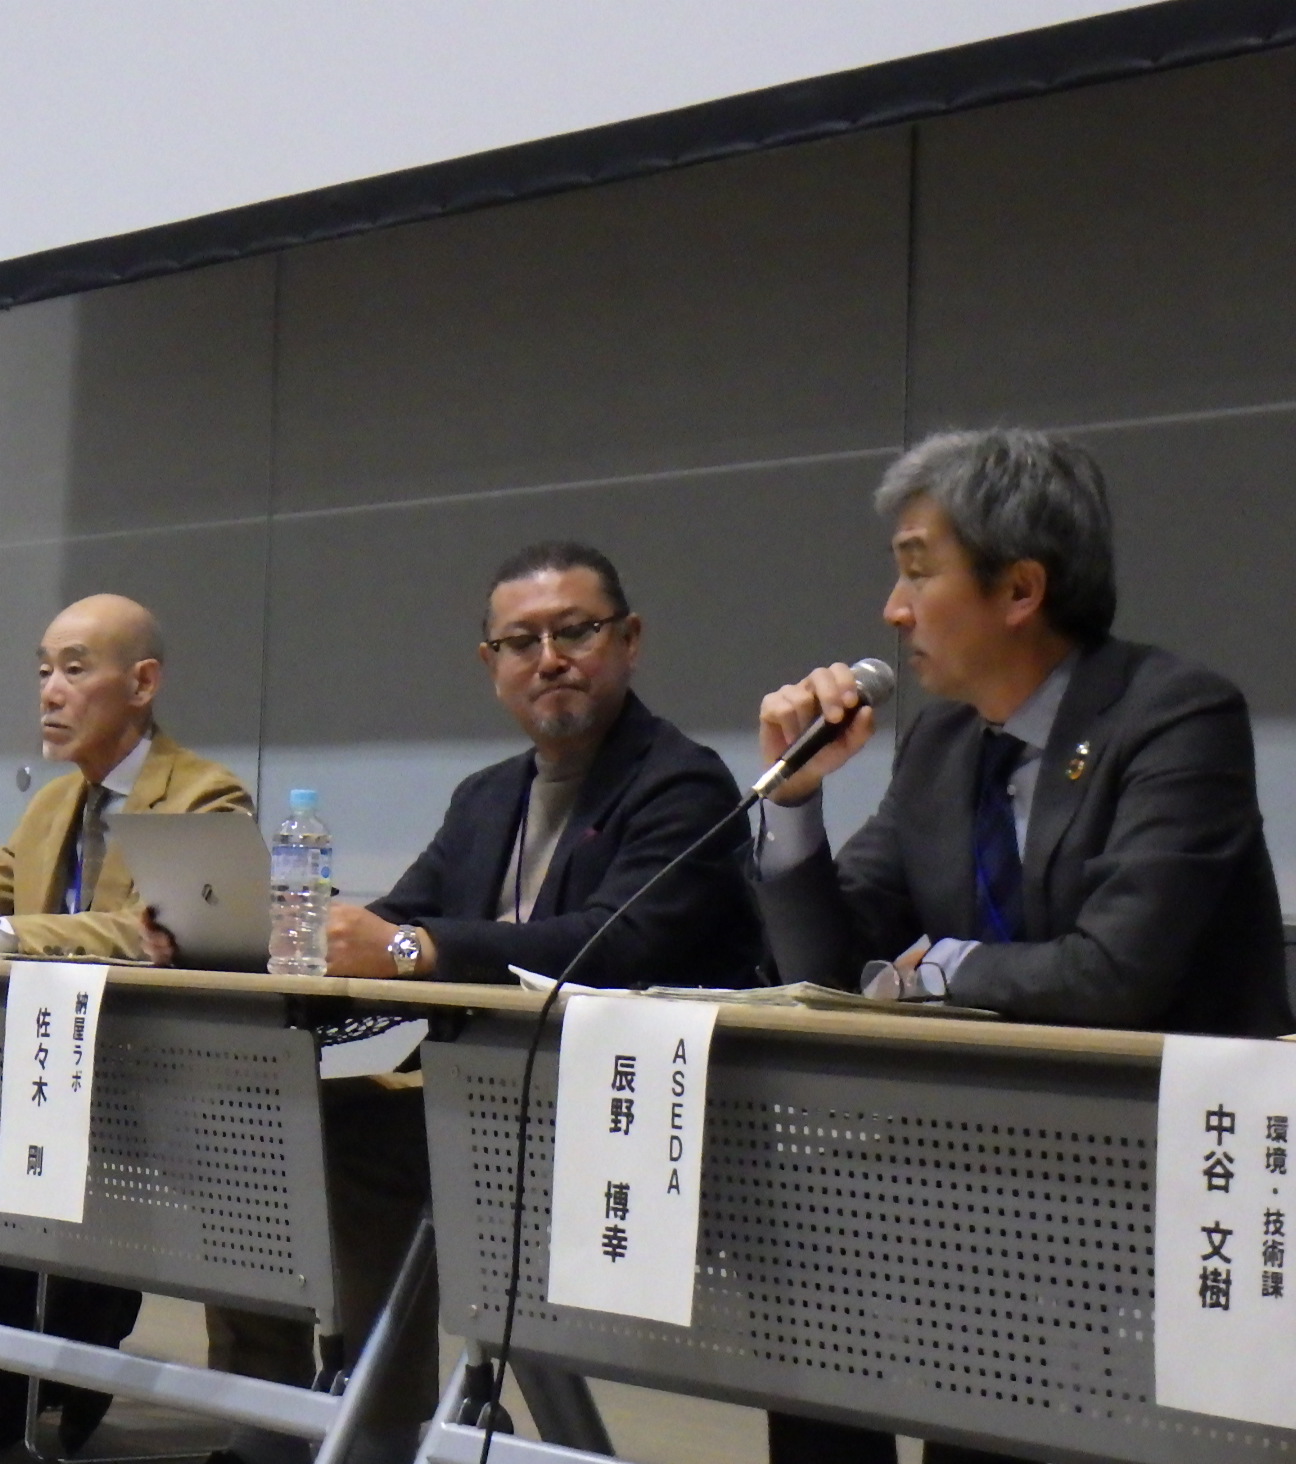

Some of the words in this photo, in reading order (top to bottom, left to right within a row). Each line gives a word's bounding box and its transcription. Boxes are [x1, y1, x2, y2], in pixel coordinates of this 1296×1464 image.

[31, 1007, 51, 1107] 佐々木
[71, 991, 89, 1093] 納屋ラボ
[609, 1054, 637, 1136] 辰野
[667, 1037, 687, 1196] ASEDA
[26, 1144, 44, 1177] 剛
[1202, 1103, 1236, 1194] 中谷
[601, 1180, 631, 1264] 博幸
[1261, 1115, 1289, 1300] 環境・技術課
[1198, 1220, 1234, 1312] 文樹
